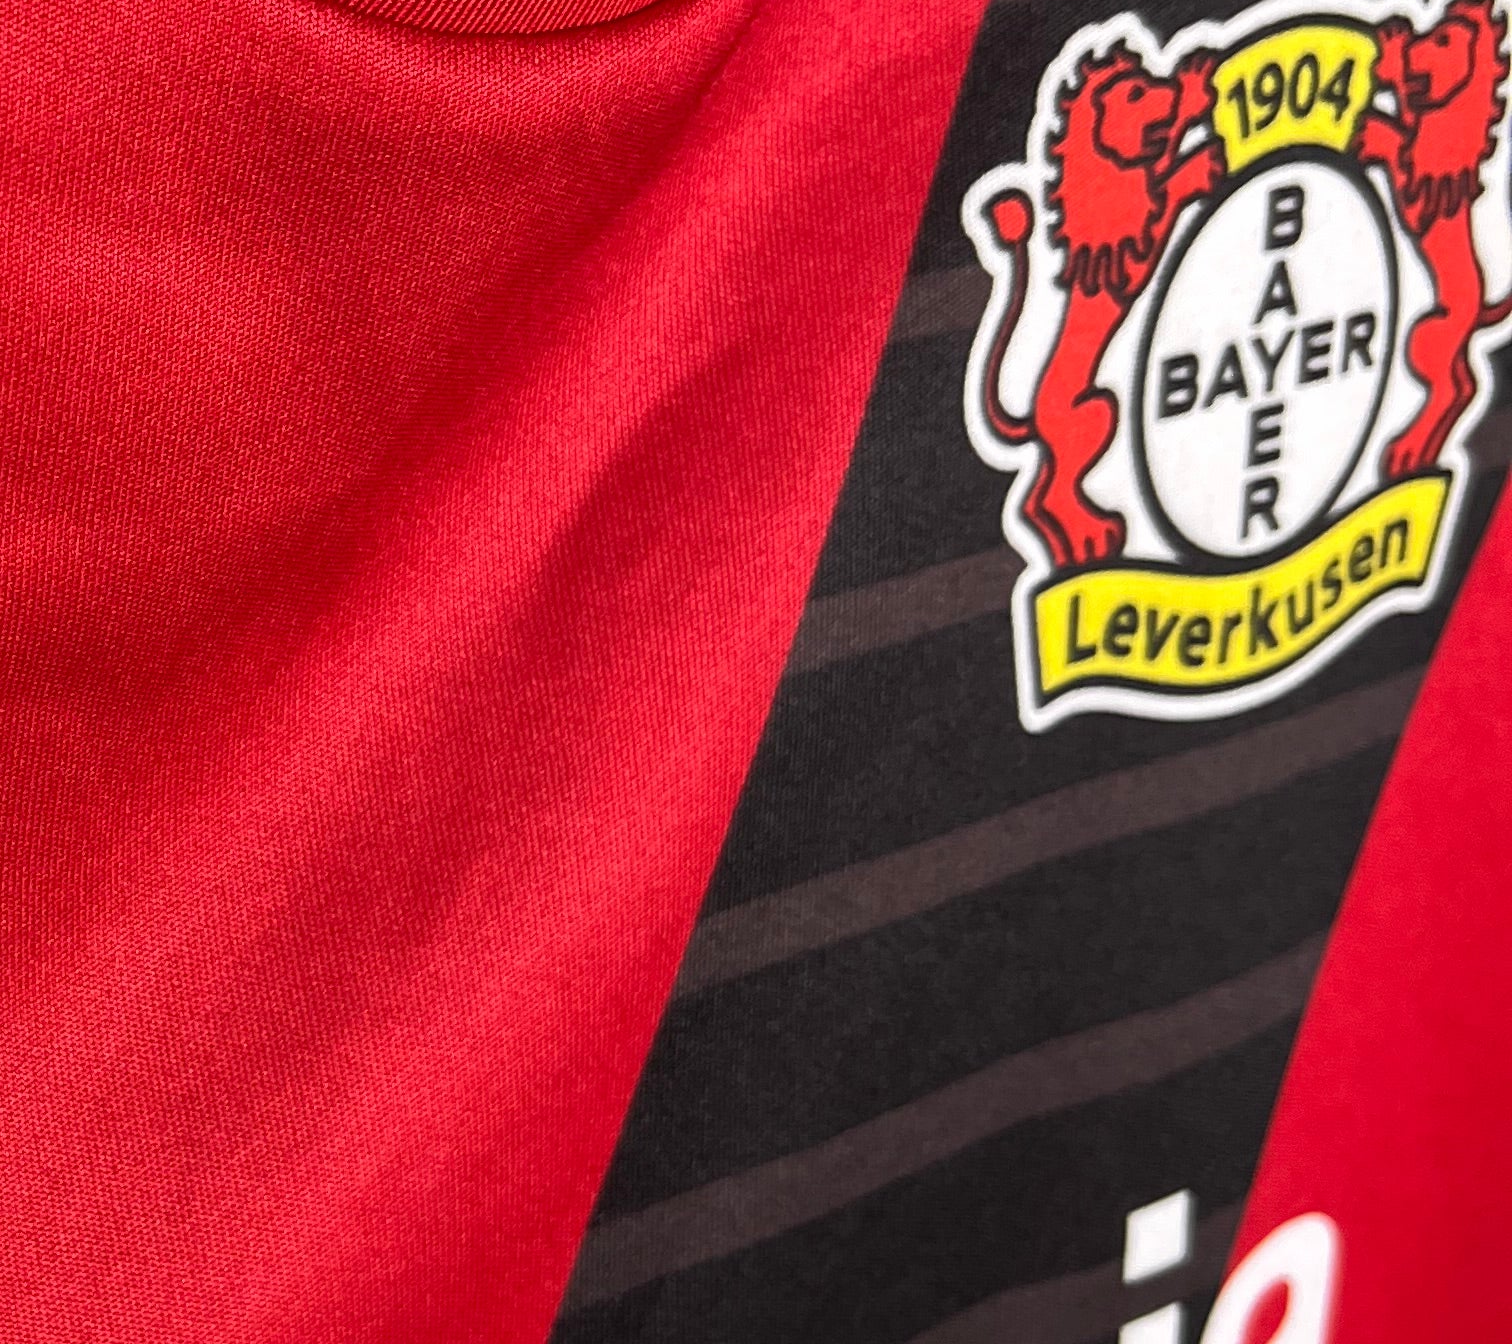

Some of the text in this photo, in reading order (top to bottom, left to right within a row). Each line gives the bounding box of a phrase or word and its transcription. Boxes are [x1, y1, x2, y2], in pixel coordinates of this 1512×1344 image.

[1224, 55, 1355, 139] 1904
[1156, 312, 1377, 422] BAYER
[1236, 186, 1306, 542] BAYER
[1064, 514, 1410, 668] Leverkusen
